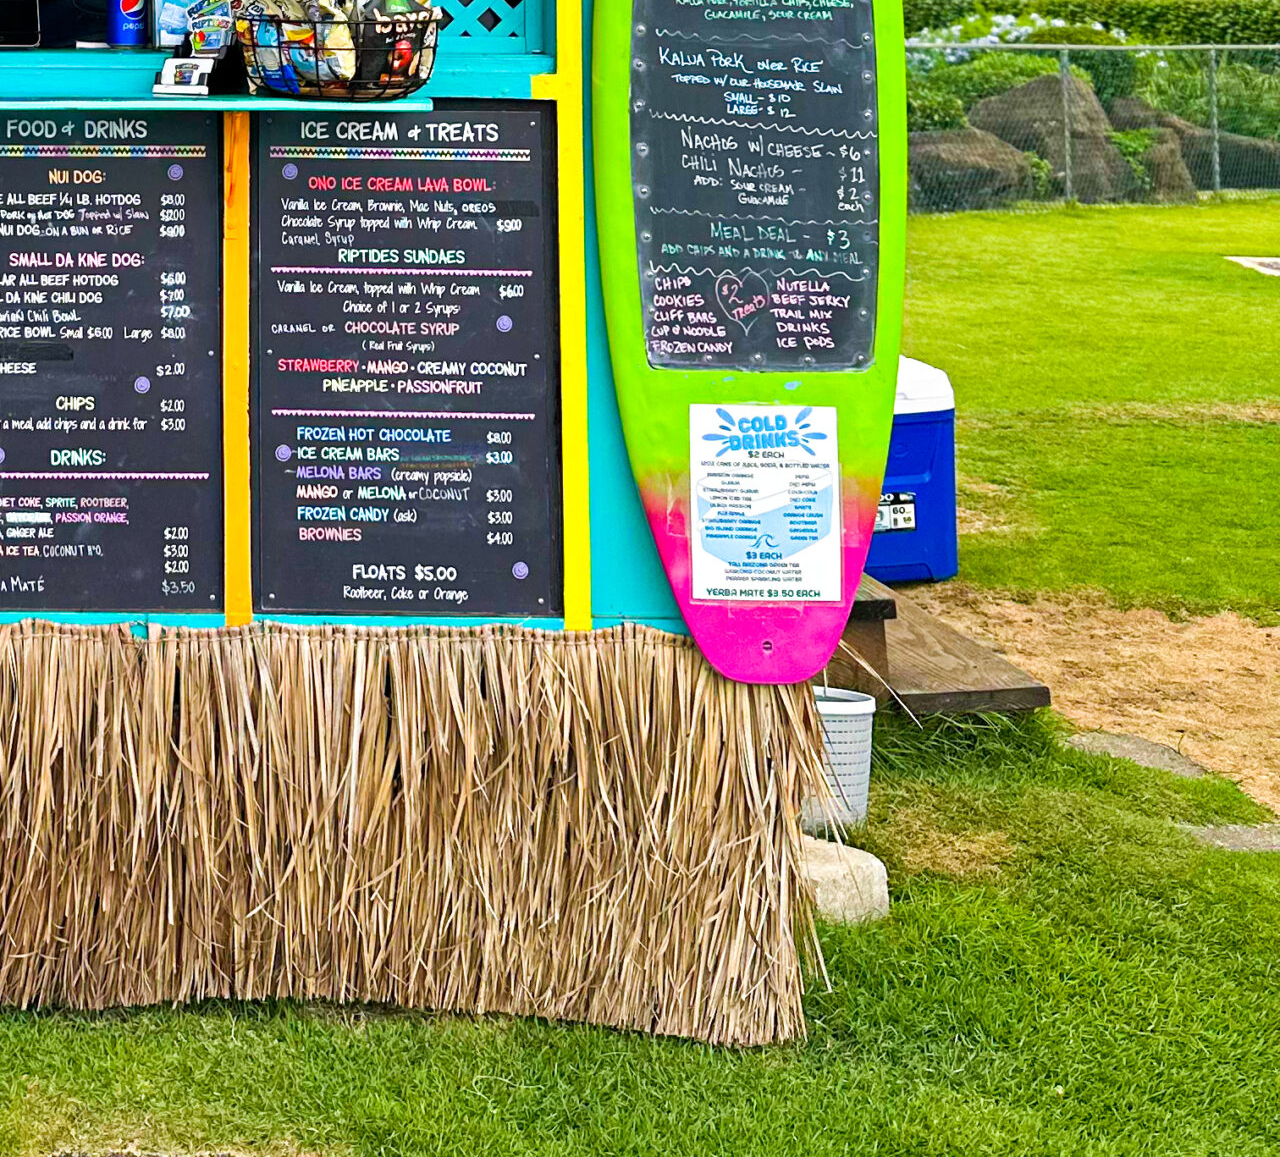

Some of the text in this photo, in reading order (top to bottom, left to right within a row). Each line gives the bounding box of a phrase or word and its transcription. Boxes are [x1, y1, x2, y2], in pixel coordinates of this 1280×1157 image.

[7, 119, 57, 138] FOOD
[85, 118, 148, 139] DRINKS
[301, 121, 329, 139] ICE
[336, 121, 398, 141] CREAM
[426, 122, 499, 142] TREATS
[49, 168, 106, 184] NUI DOG:
[309, 176, 497, 192] ONO ICE CREAM LAVA BOWL:
[10, 251, 145, 267] SMALL DA KINE DOG:
[338, 249, 466, 264] RIPTIDES SUNDAES
[20, 274, 38, 286] ALL
[41, 274, 70, 286] BEEF
[72, 274, 119, 287] HOTDOG
[776, 279, 830, 293] NUTELLA
[653, 294, 705, 307] COOKIES
[771, 294, 850, 308] BEEF JERKY
[770, 307, 832, 319] TRAIL MIX
[776, 322, 830, 334] DRINKS
[56, 396, 95, 412] CHIPS
[738, 415, 787, 433] COLD
[297, 426, 345, 442] FROZEN
[348, 429, 375, 442] HOT
[379, 428, 452, 442] CHOCOLATE
[728, 430, 800, 451] DRINKS
[50, 448, 106, 466] DRINKS:
[18, 497, 42, 508] COKE,
[45, 497, 78, 509] SPRITE,
[80, 497, 129, 509] ROOTBEER,
[299, 528, 362, 542] BROWNIES
[746, 551, 758, 560] $3
[353, 563, 457, 581] FLOATS $5.00
[707, 588, 737, 596] YERBA
[739, 589, 764, 597] MATE
[796, 589, 821, 598] EACH
